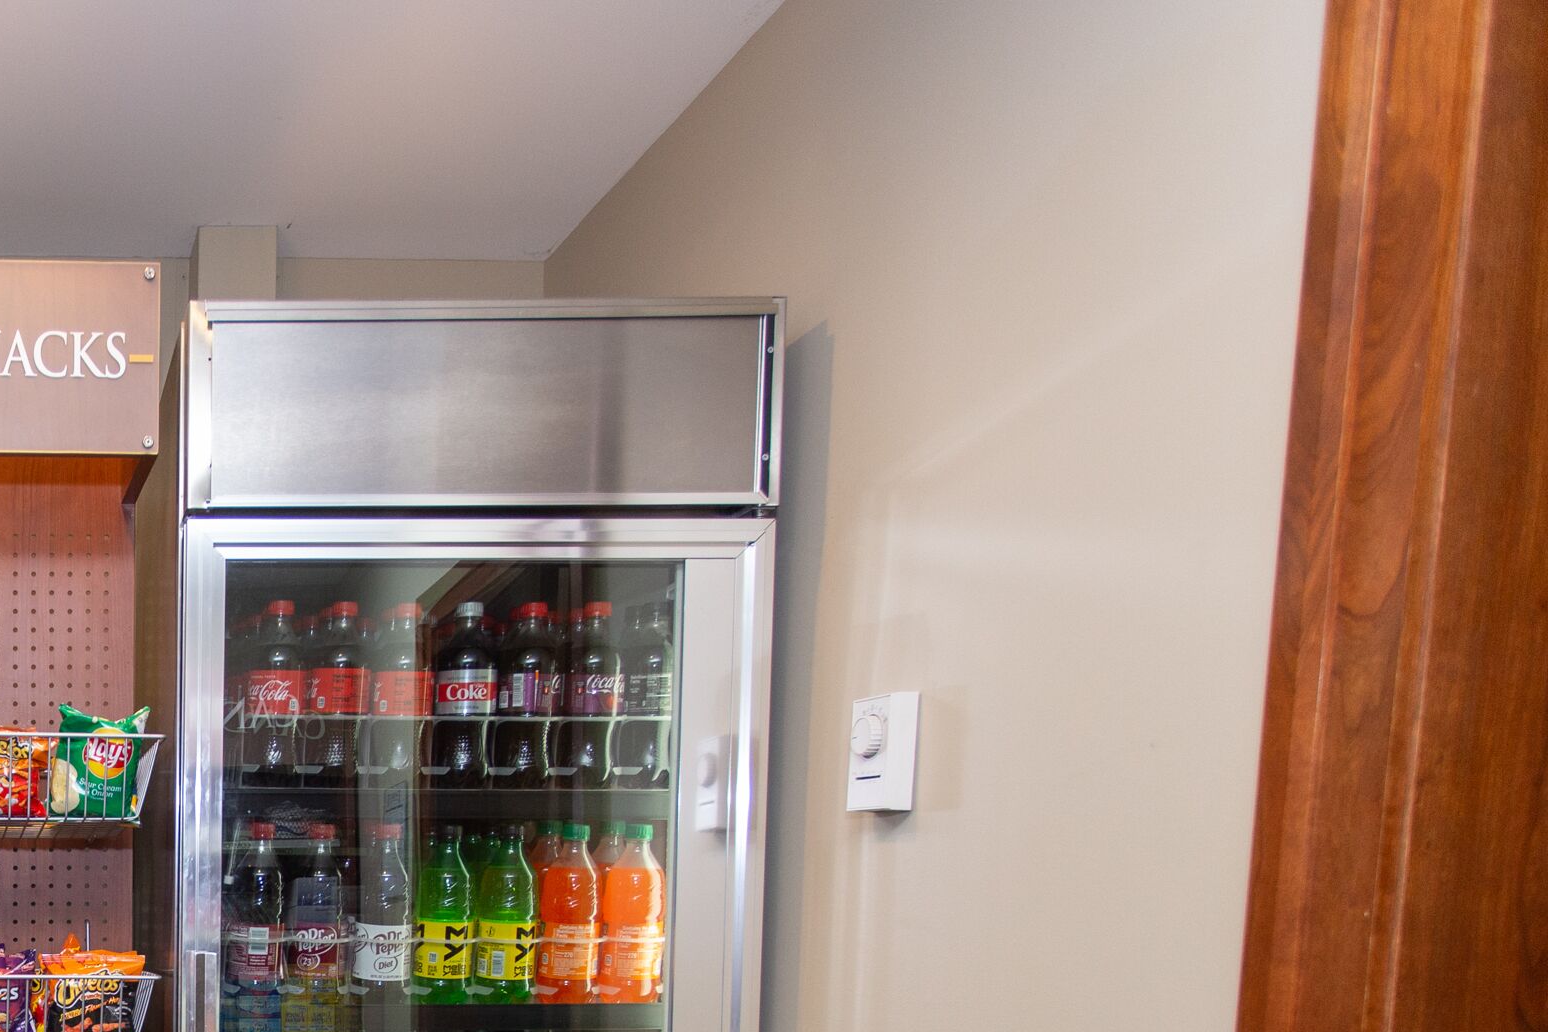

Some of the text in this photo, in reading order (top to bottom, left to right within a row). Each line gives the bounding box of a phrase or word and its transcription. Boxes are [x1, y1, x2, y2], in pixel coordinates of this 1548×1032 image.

[446, 684, 487, 701] Coke
[79, 777, 122, 792] Sur Ceam
[302, 957, 312, 967] 23
[378, 961, 394, 970] Diet
